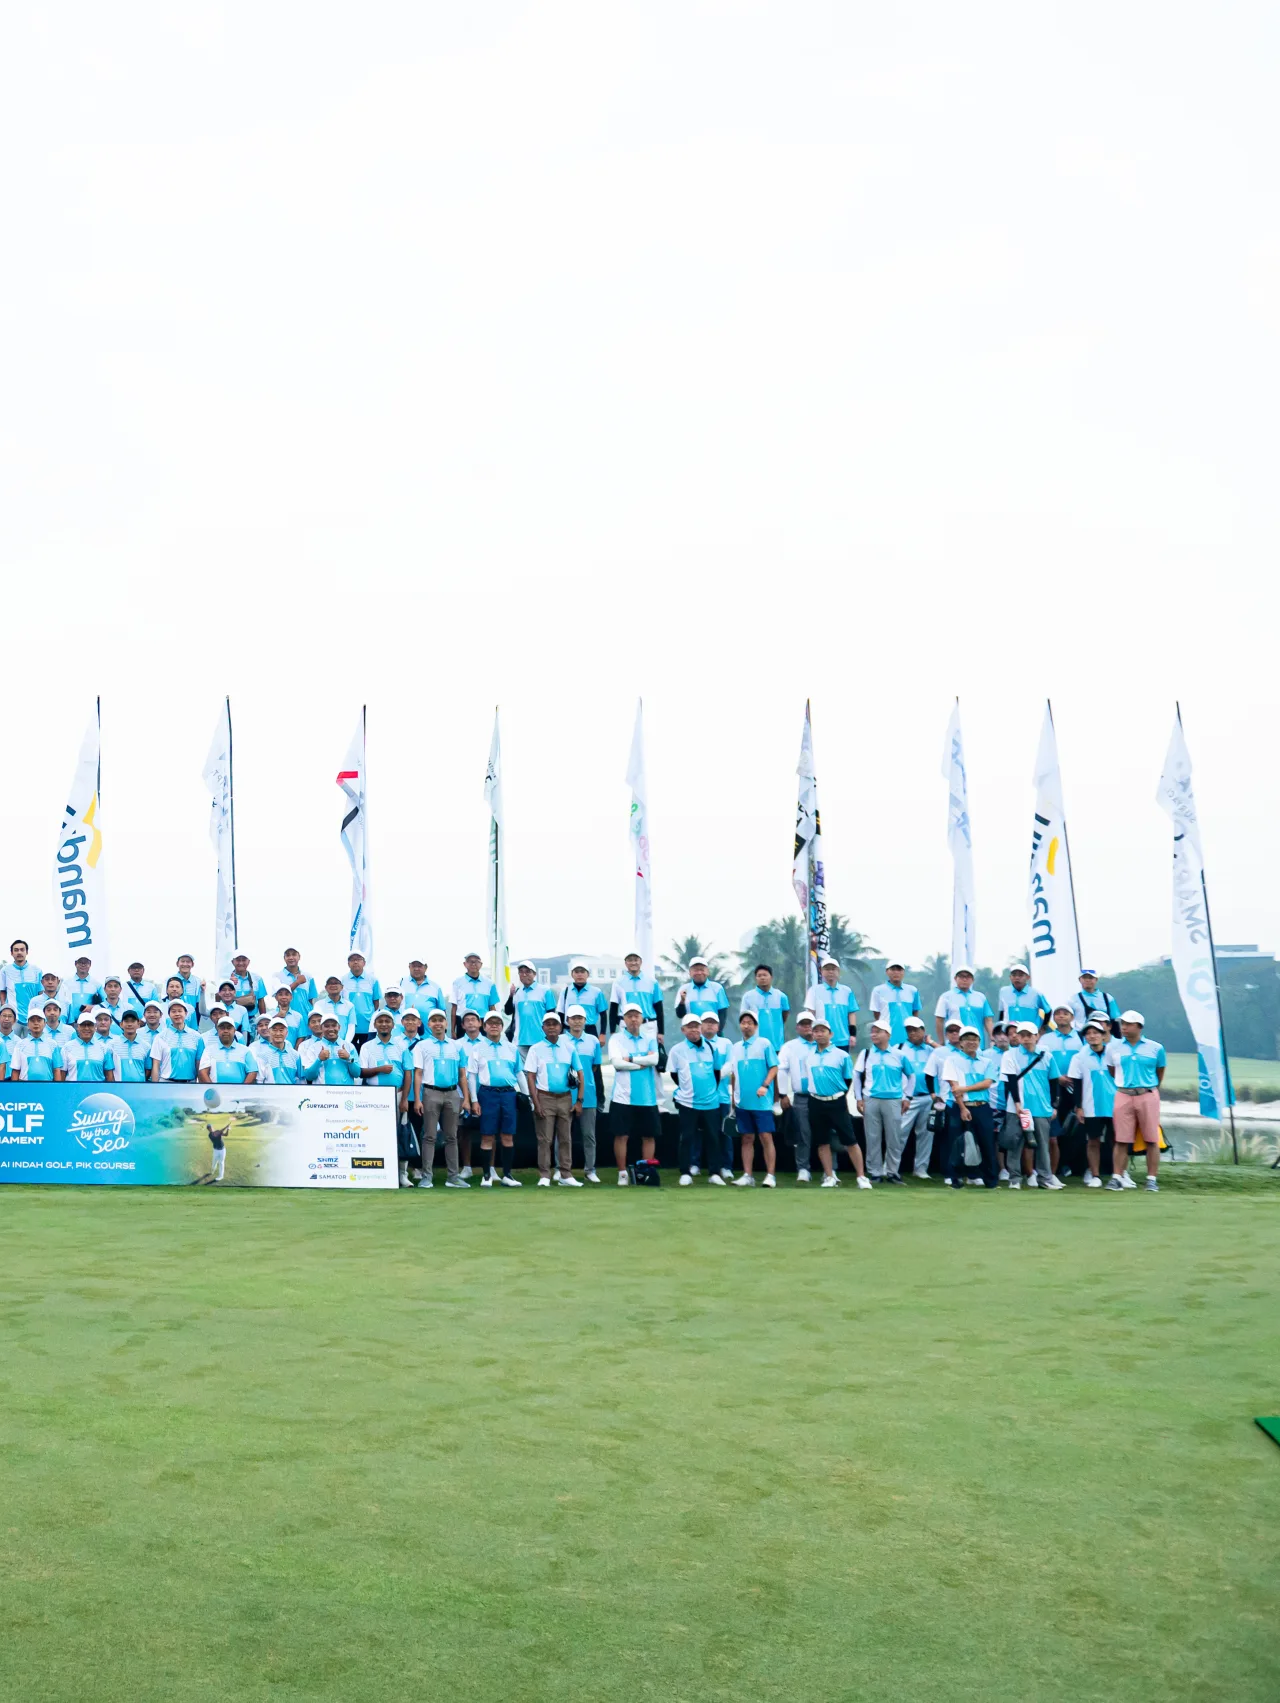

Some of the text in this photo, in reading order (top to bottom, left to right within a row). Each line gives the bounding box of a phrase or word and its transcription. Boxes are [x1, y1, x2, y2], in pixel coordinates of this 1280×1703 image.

[71, 1109, 128, 1135] Swing
[81, 1128, 111, 1141] by the
[323, 1130, 360, 1139] mandiri
[92, 1137, 130, 1155] Sea
[12, 1161, 44, 1169] INDAH
[45, 1161, 74, 1170] GOLF,
[94, 1162, 136, 1170] COURSE
